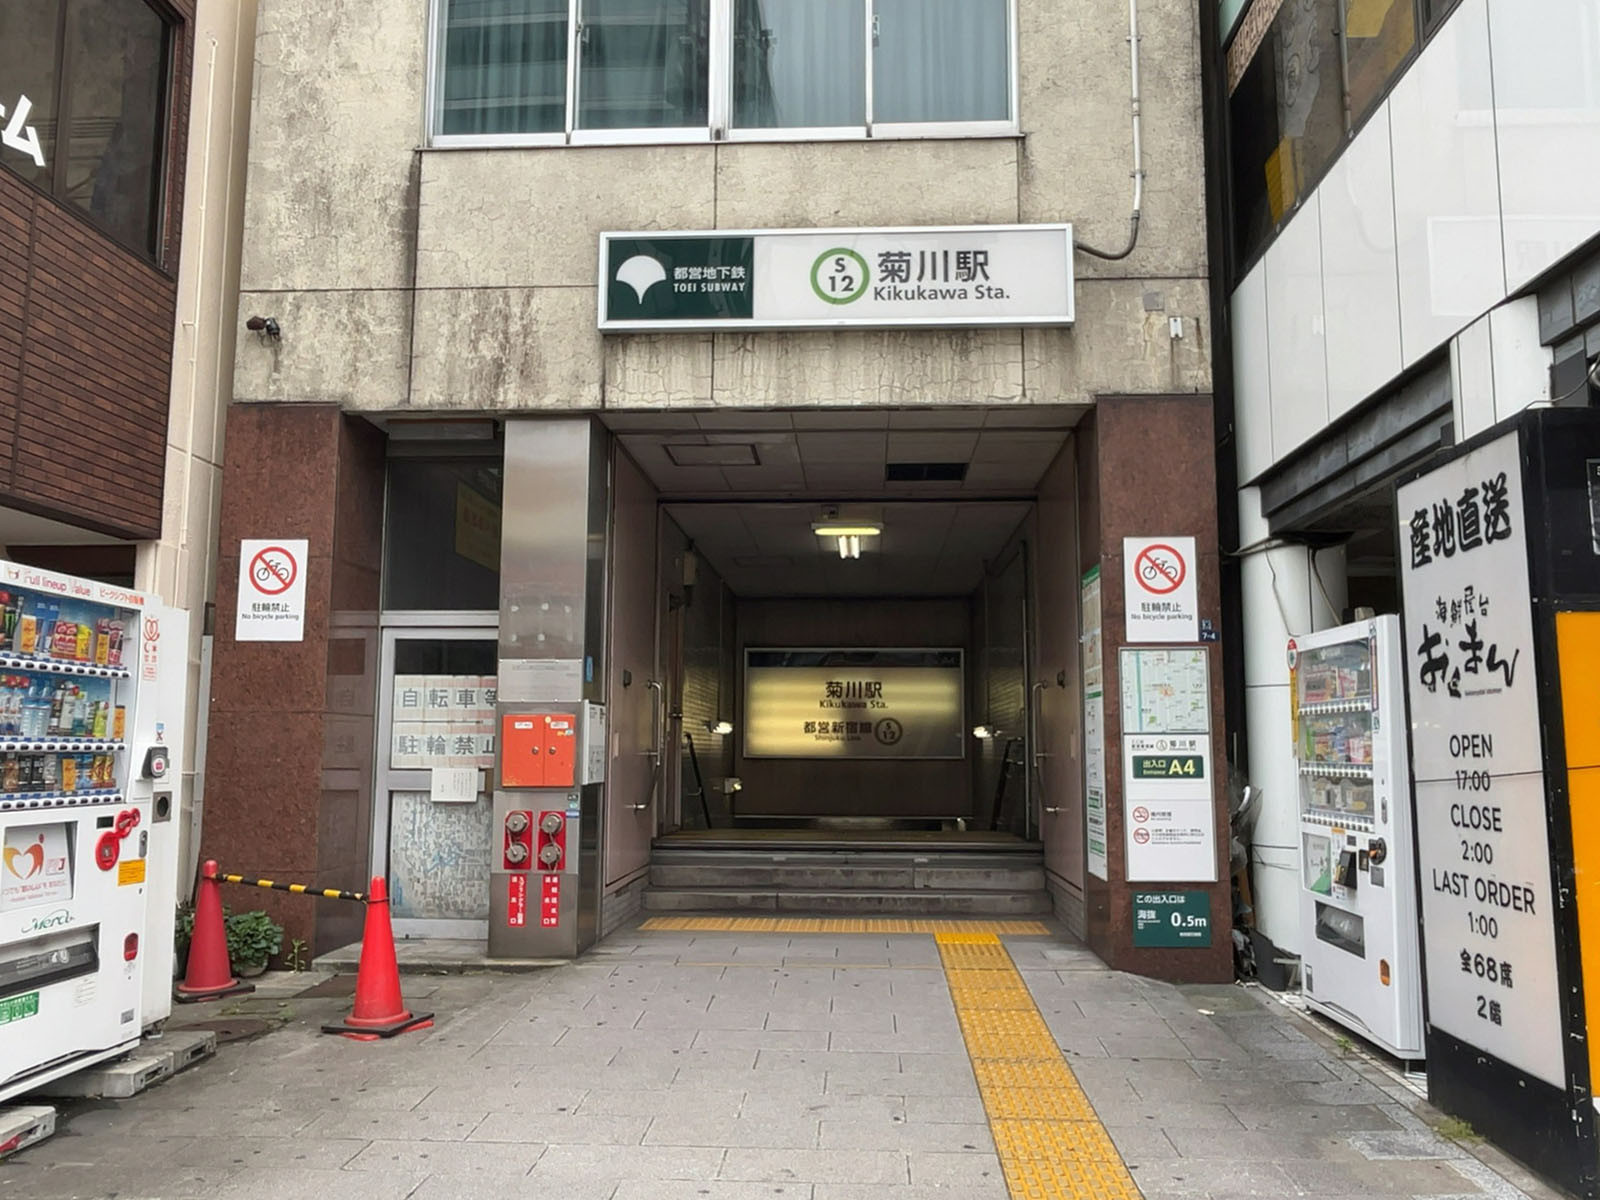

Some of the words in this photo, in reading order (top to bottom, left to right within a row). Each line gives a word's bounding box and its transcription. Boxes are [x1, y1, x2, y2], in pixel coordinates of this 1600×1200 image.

[0, 94, 46, 167] ム
[835, 257, 847, 273] S
[878, 250, 990, 284] 菊川駅
[673, 266, 746, 281] 都営地下鉄
[673, 282, 698, 293] TOEI
[701, 281, 746, 292] SUBWAY
[828, 275, 855, 293] 12
[874, 284, 968, 301] Kikukawa
[975, 283, 1011, 299] Sta.
[1409, 472, 1512, 570] 産地直送
[252, 603, 290, 612] 駐輪禁止
[1141, 602, 1182, 612] 駐輪禁止
[275, 613, 299, 621] parking
[1142, 613, 1166, 621] bicycle
[1167, 613, 1193, 621] parking
[402, 687, 497, 708] 自転車等
[825, 681, 883, 699] 菊川駅
[819, 700, 867, 709] Kikukawa
[870, 700, 889, 709] Sta.
[804, 721, 873, 734] 都営新宿線
[886, 722, 892, 730] S
[882, 731, 896, 740] 12
[1449, 734, 1493, 759] OPEN
[1143, 760, 1166, 768] 出入口
[1168, 759, 1196, 775] A4
[1455, 770, 1491, 792] 17:00
[1450, 803, 1503, 833] CLOSE
[1461, 840, 1493, 865] 2:00
[1136, 895, 1186, 904] この出入口は
[1432, 868, 1469, 899] LAST
[1474, 878, 1536, 915] ORDER
[1137, 909, 1157, 919] 海抜
[1170, 912, 1207, 927] 0.5m
[1467, 911, 1498, 939] 1:00
[1459, 949, 1513, 988] 全68席
[1476, 995, 1502, 1026] 2階
